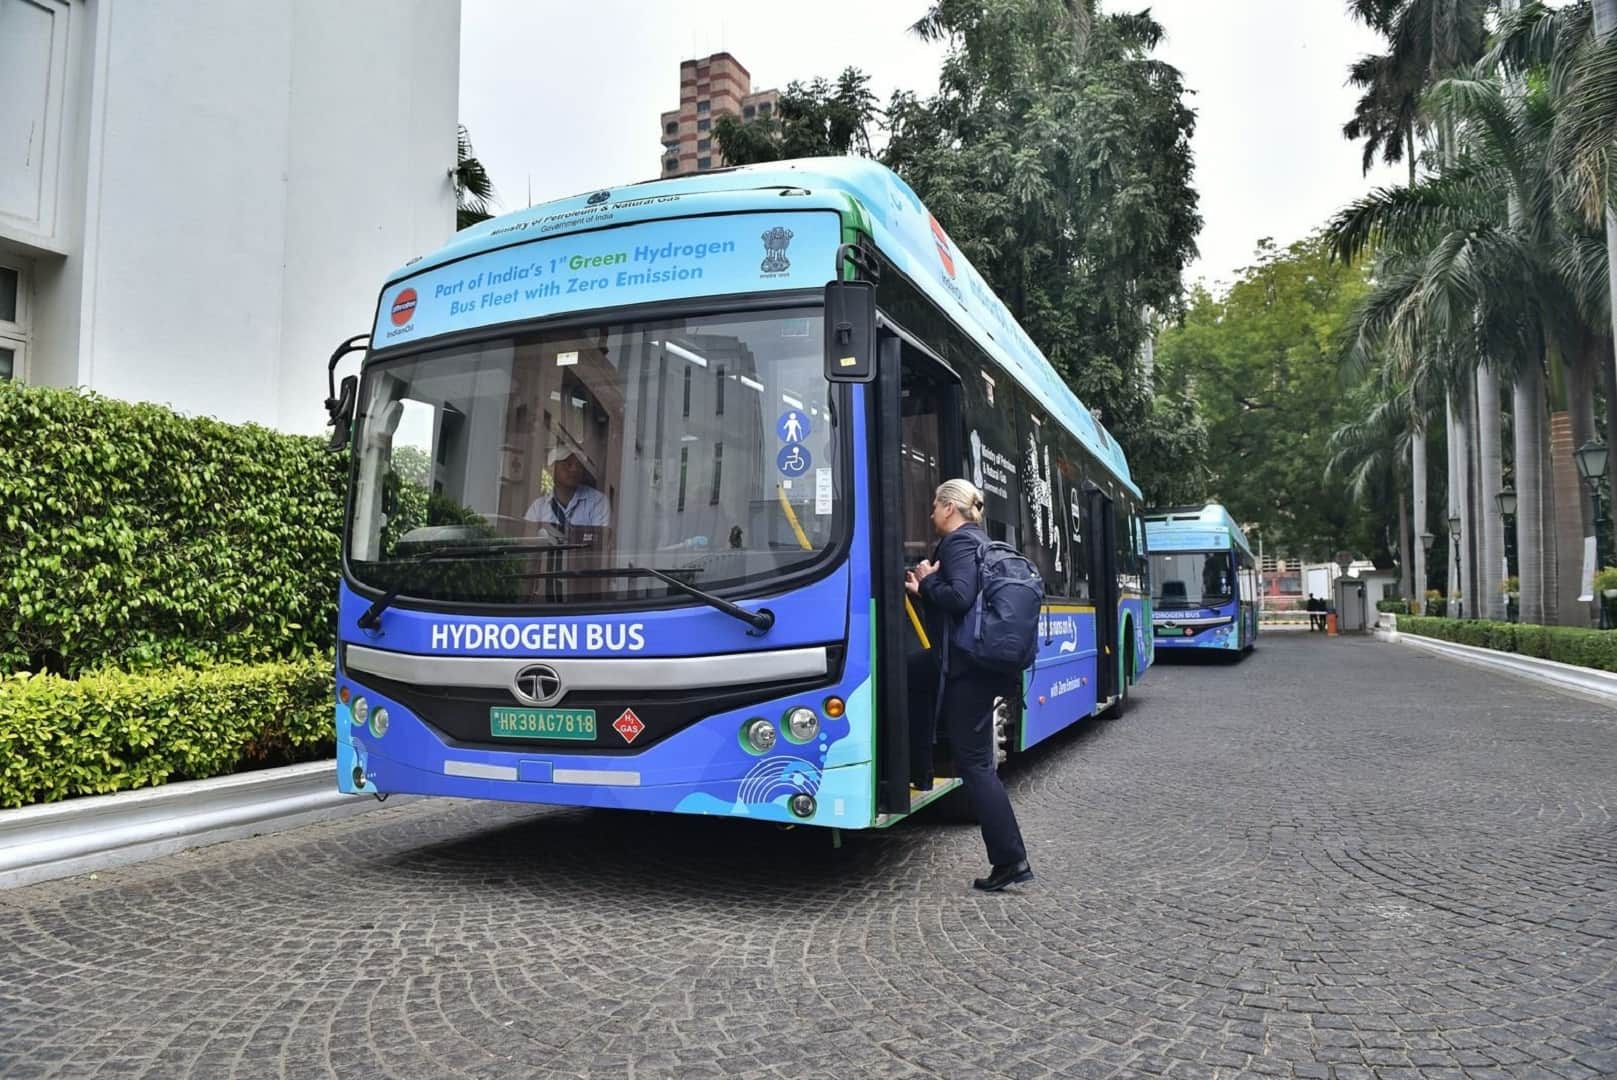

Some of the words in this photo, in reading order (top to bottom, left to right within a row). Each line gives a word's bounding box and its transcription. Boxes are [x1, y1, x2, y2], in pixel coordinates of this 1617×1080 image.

[531, 217, 544, 228] of
[544, 207, 598, 222] Petroleum
[600, 204, 608, 212] &
[612, 199, 655, 210] Natural
[541, 217, 585, 233] Government
[585, 215, 594, 225] of
[595, 212, 614, 222] India
[434, 279, 465, 299] Part
[467, 273, 485, 291] of
[487, 262, 543, 286] India's
[569, 251, 628, 271] Green
[633, 239, 736, 263] Hydrogen
[450, 299, 477, 317] Bus
[480, 288, 520, 309] Fleet
[525, 280, 561, 300] with
[565, 276, 610, 295] Zero
[614, 264, 704, 288] Emission
[431, 623, 577, 650] HYDROGEN
[586, 623, 645, 651] BUS
[500, 712, 594, 733] HR38AG7818
[619, 725, 638, 734] GAS
[624, 714, 635, 725] H2
